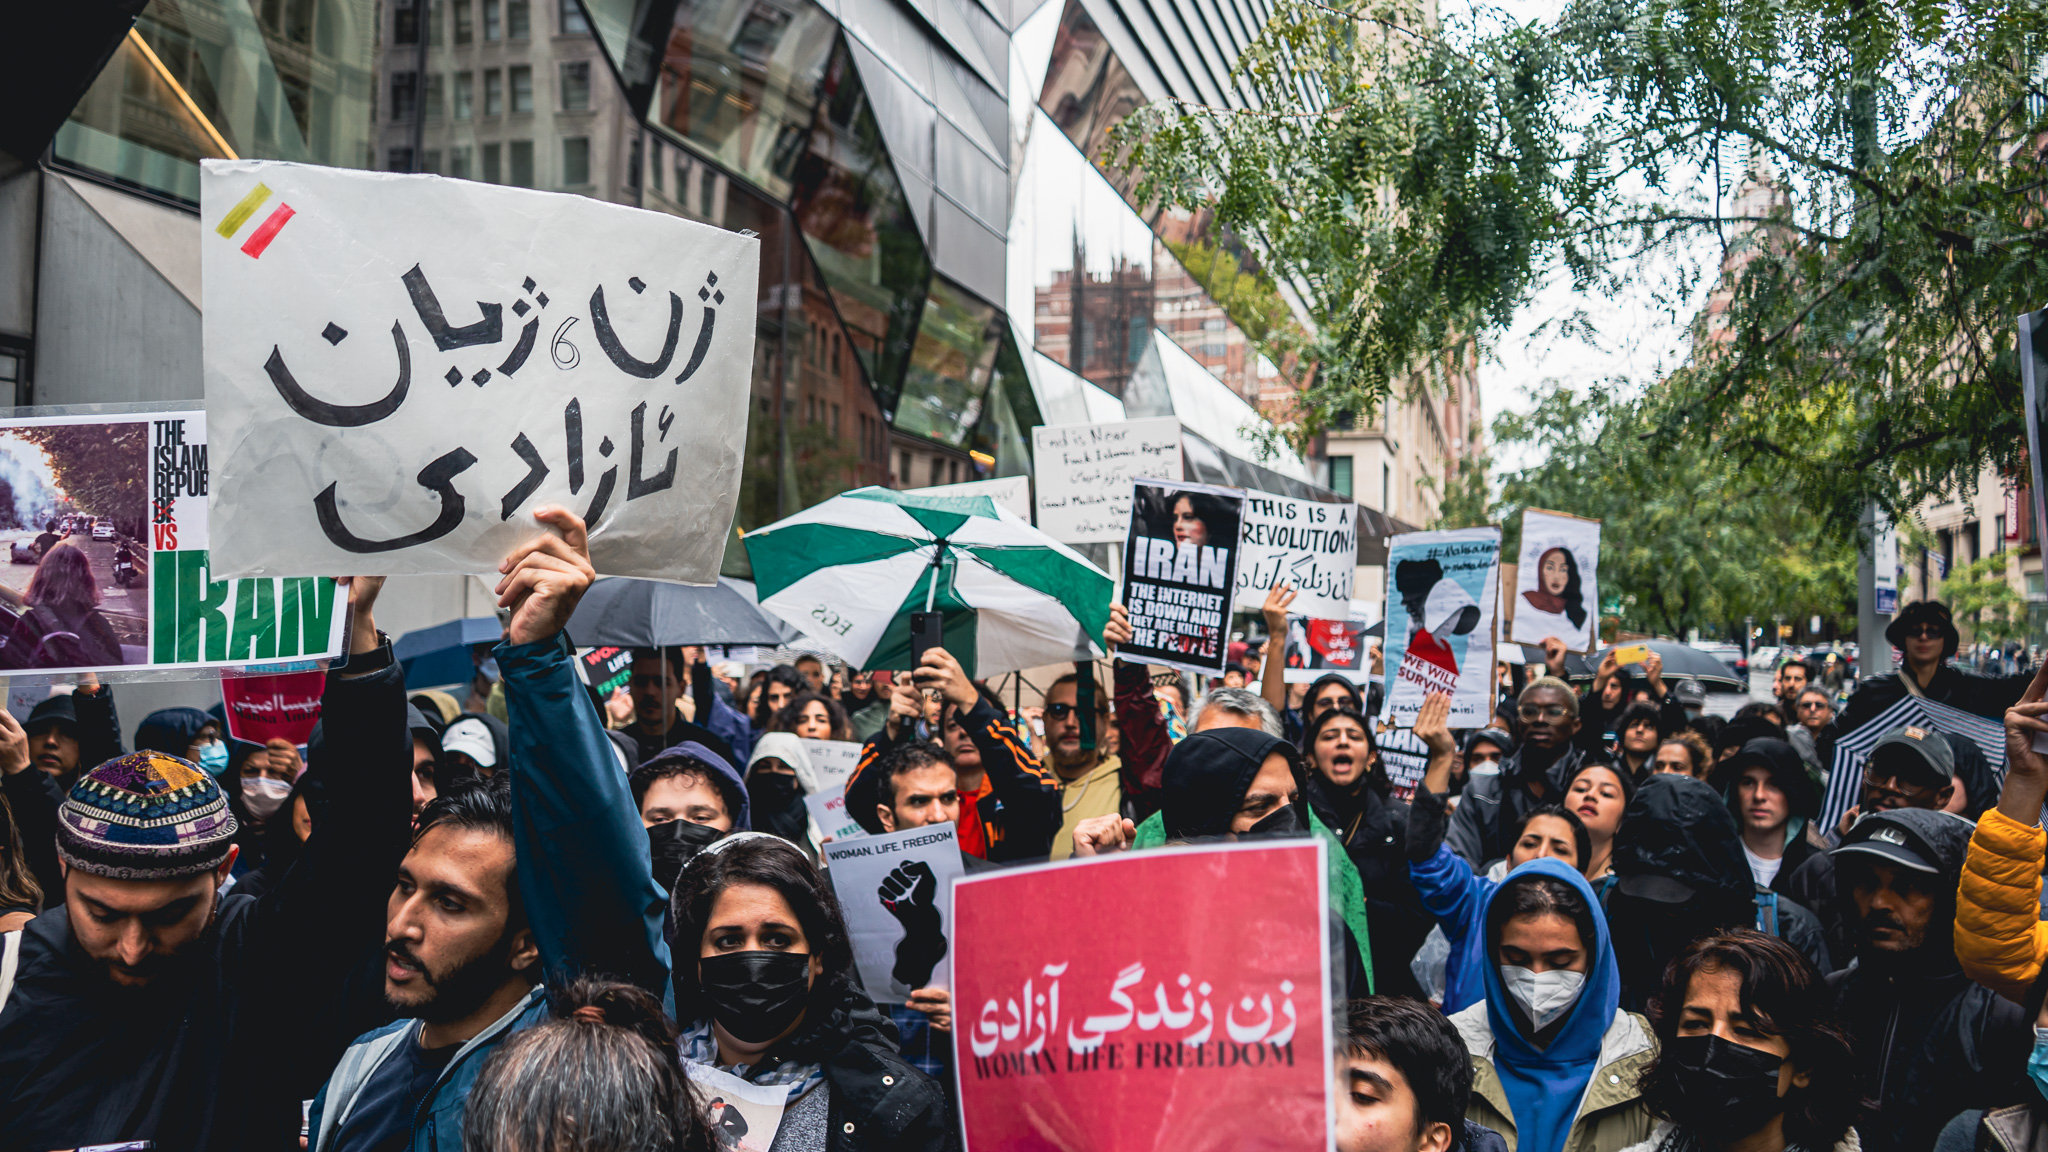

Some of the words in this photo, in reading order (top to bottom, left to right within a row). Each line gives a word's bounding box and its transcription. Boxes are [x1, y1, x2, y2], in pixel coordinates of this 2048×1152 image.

[154, 419, 186, 446] THE
[154, 444, 209, 472] ISLAM
[154, 470, 209, 498] REPUB
[1248, 498, 1297, 520] THIS
[1308, 506, 1327, 524] IS
[1339, 507, 1348, 525] A
[154, 523, 178, 551] VS
[1133, 535, 1229, 590] IRAN
[154, 550, 338, 665] IRAN
[1130, 581, 1156, 600] THE
[1157, 585, 1225, 612] INTERNET
[1127, 613, 1154, 629] THEY
[1154, 618, 1176, 633] ARE
[1176, 621, 1219, 640] KILLING
[1128, 597, 1144, 614] IS
[1144, 600, 1190, 624] DOWN
[1189, 608, 1222, 628] AND
[1157, 630, 1219, 659] PEOPLE
[607, 650, 633, 674] LIFE
[1404, 654, 1425, 671] WE
[1428, 664, 1457, 689] WILL
[1398, 666, 1455, 697] SURVIVE
[829, 846, 874, 861] WOMAN.
[875, 841, 902, 855] LIFE.
[902, 831, 954, 850] FREEDOM
[970, 960, 1069, 1058] آزادی
[1067, 961, 1214, 1055] زندگی
[1226, 971, 1297, 1048] زن
[974, 1046, 1057, 1080] WOMAN
[1066, 1041, 1124, 1074] LIFE
[1135, 1038, 1295, 1070] FREEDOM
